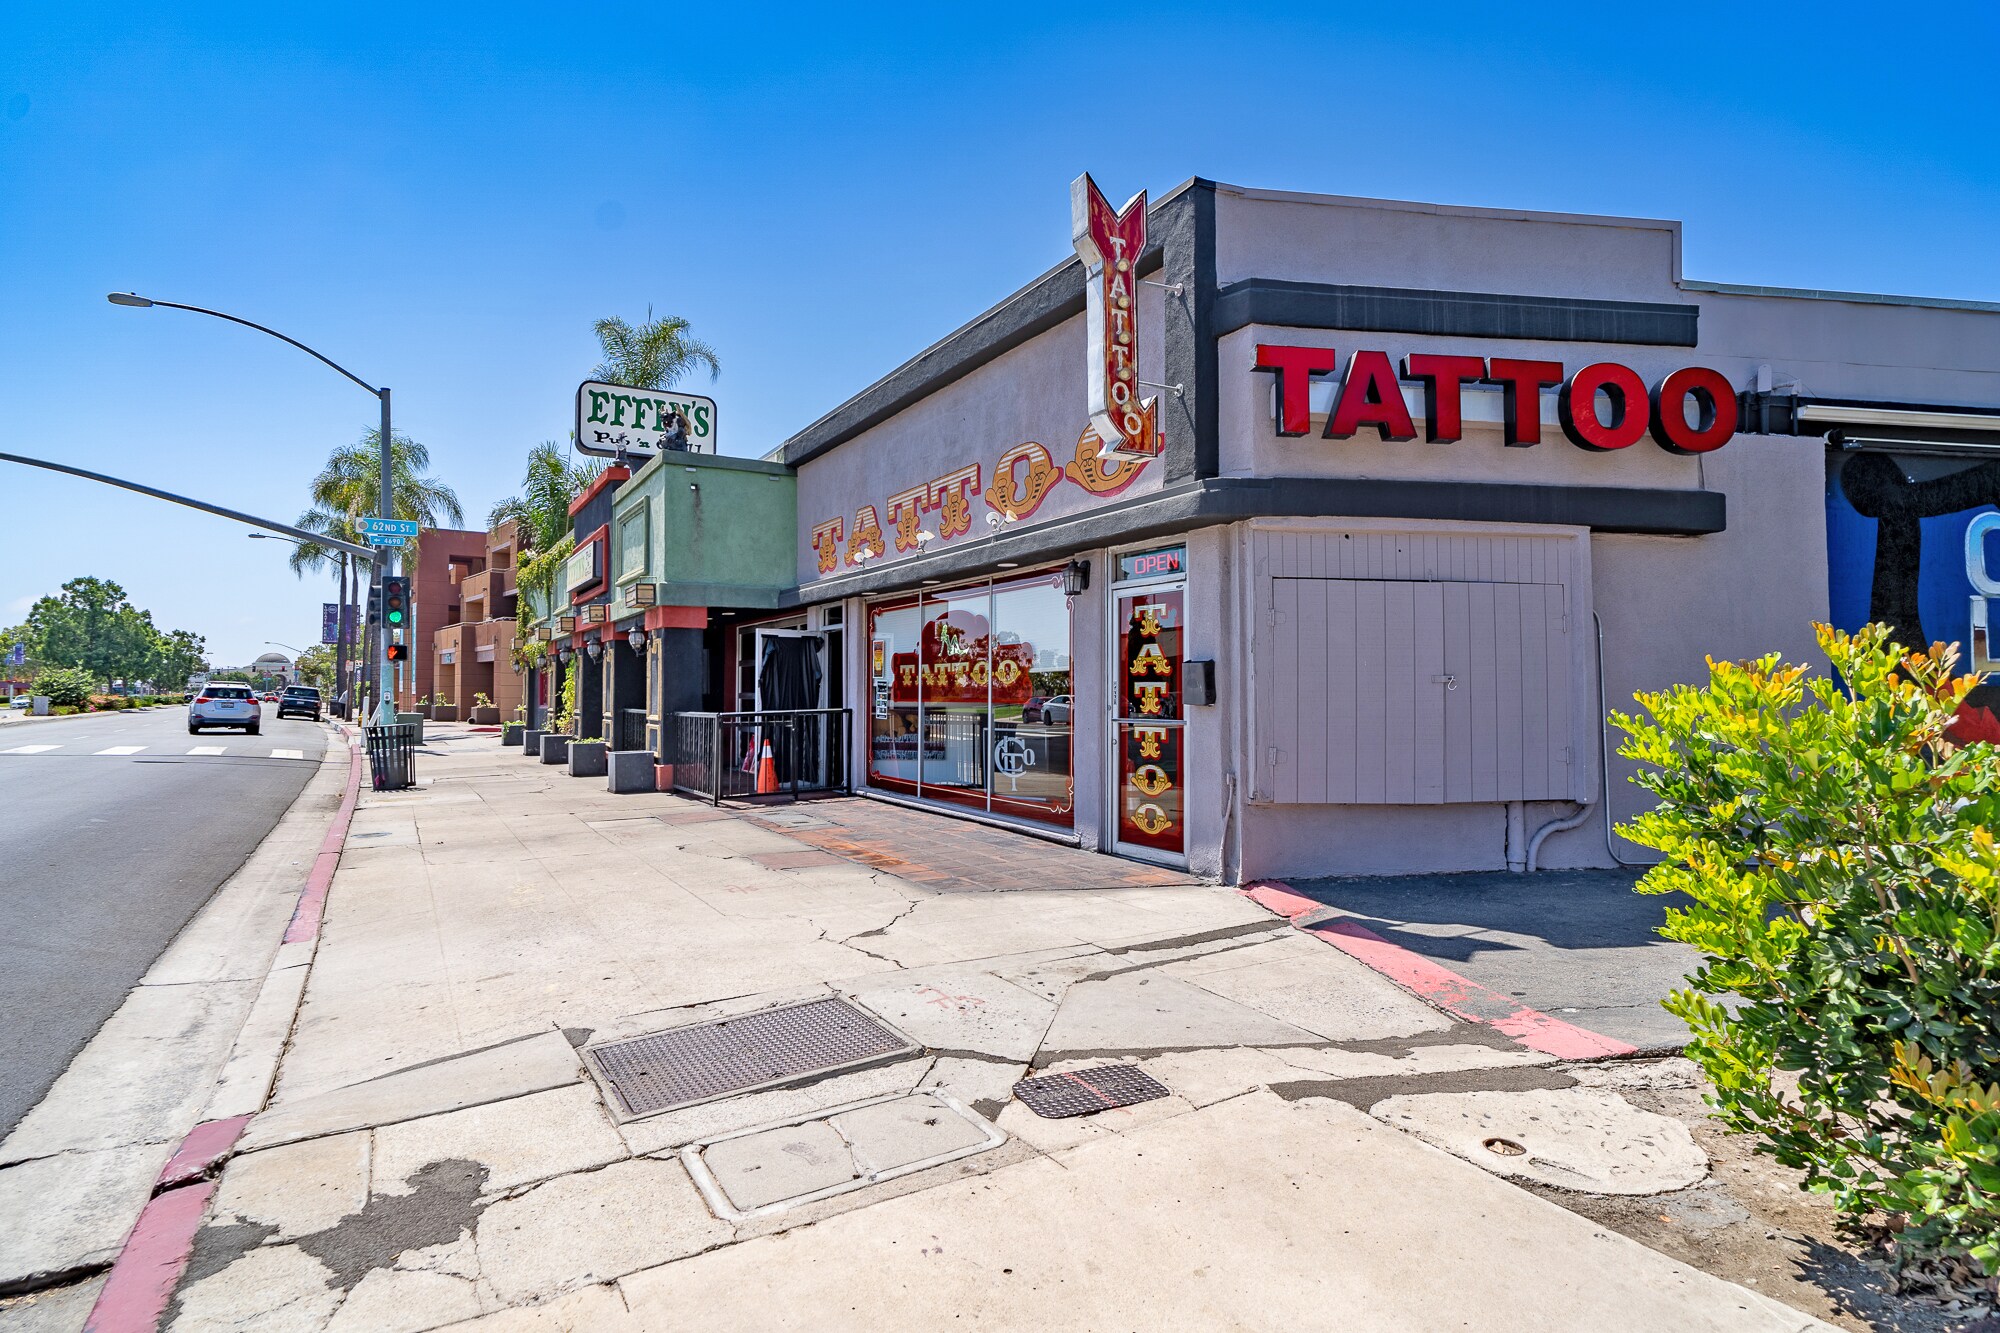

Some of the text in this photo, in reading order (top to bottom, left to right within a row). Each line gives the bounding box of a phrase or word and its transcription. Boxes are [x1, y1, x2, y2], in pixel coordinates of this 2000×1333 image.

[1109, 236, 1142, 435] TATTOO
[1254, 343, 1739, 455] TATTOO
[372, 521, 397, 531] 62ND
[812, 421, 1165, 574] TATTOO
[384, 537, 400, 545] 4690
[1134, 551, 1179, 575] OPEN
[900, 660, 1021, 687] TATTOO
[1130, 603, 1172, 835] TATTOO
